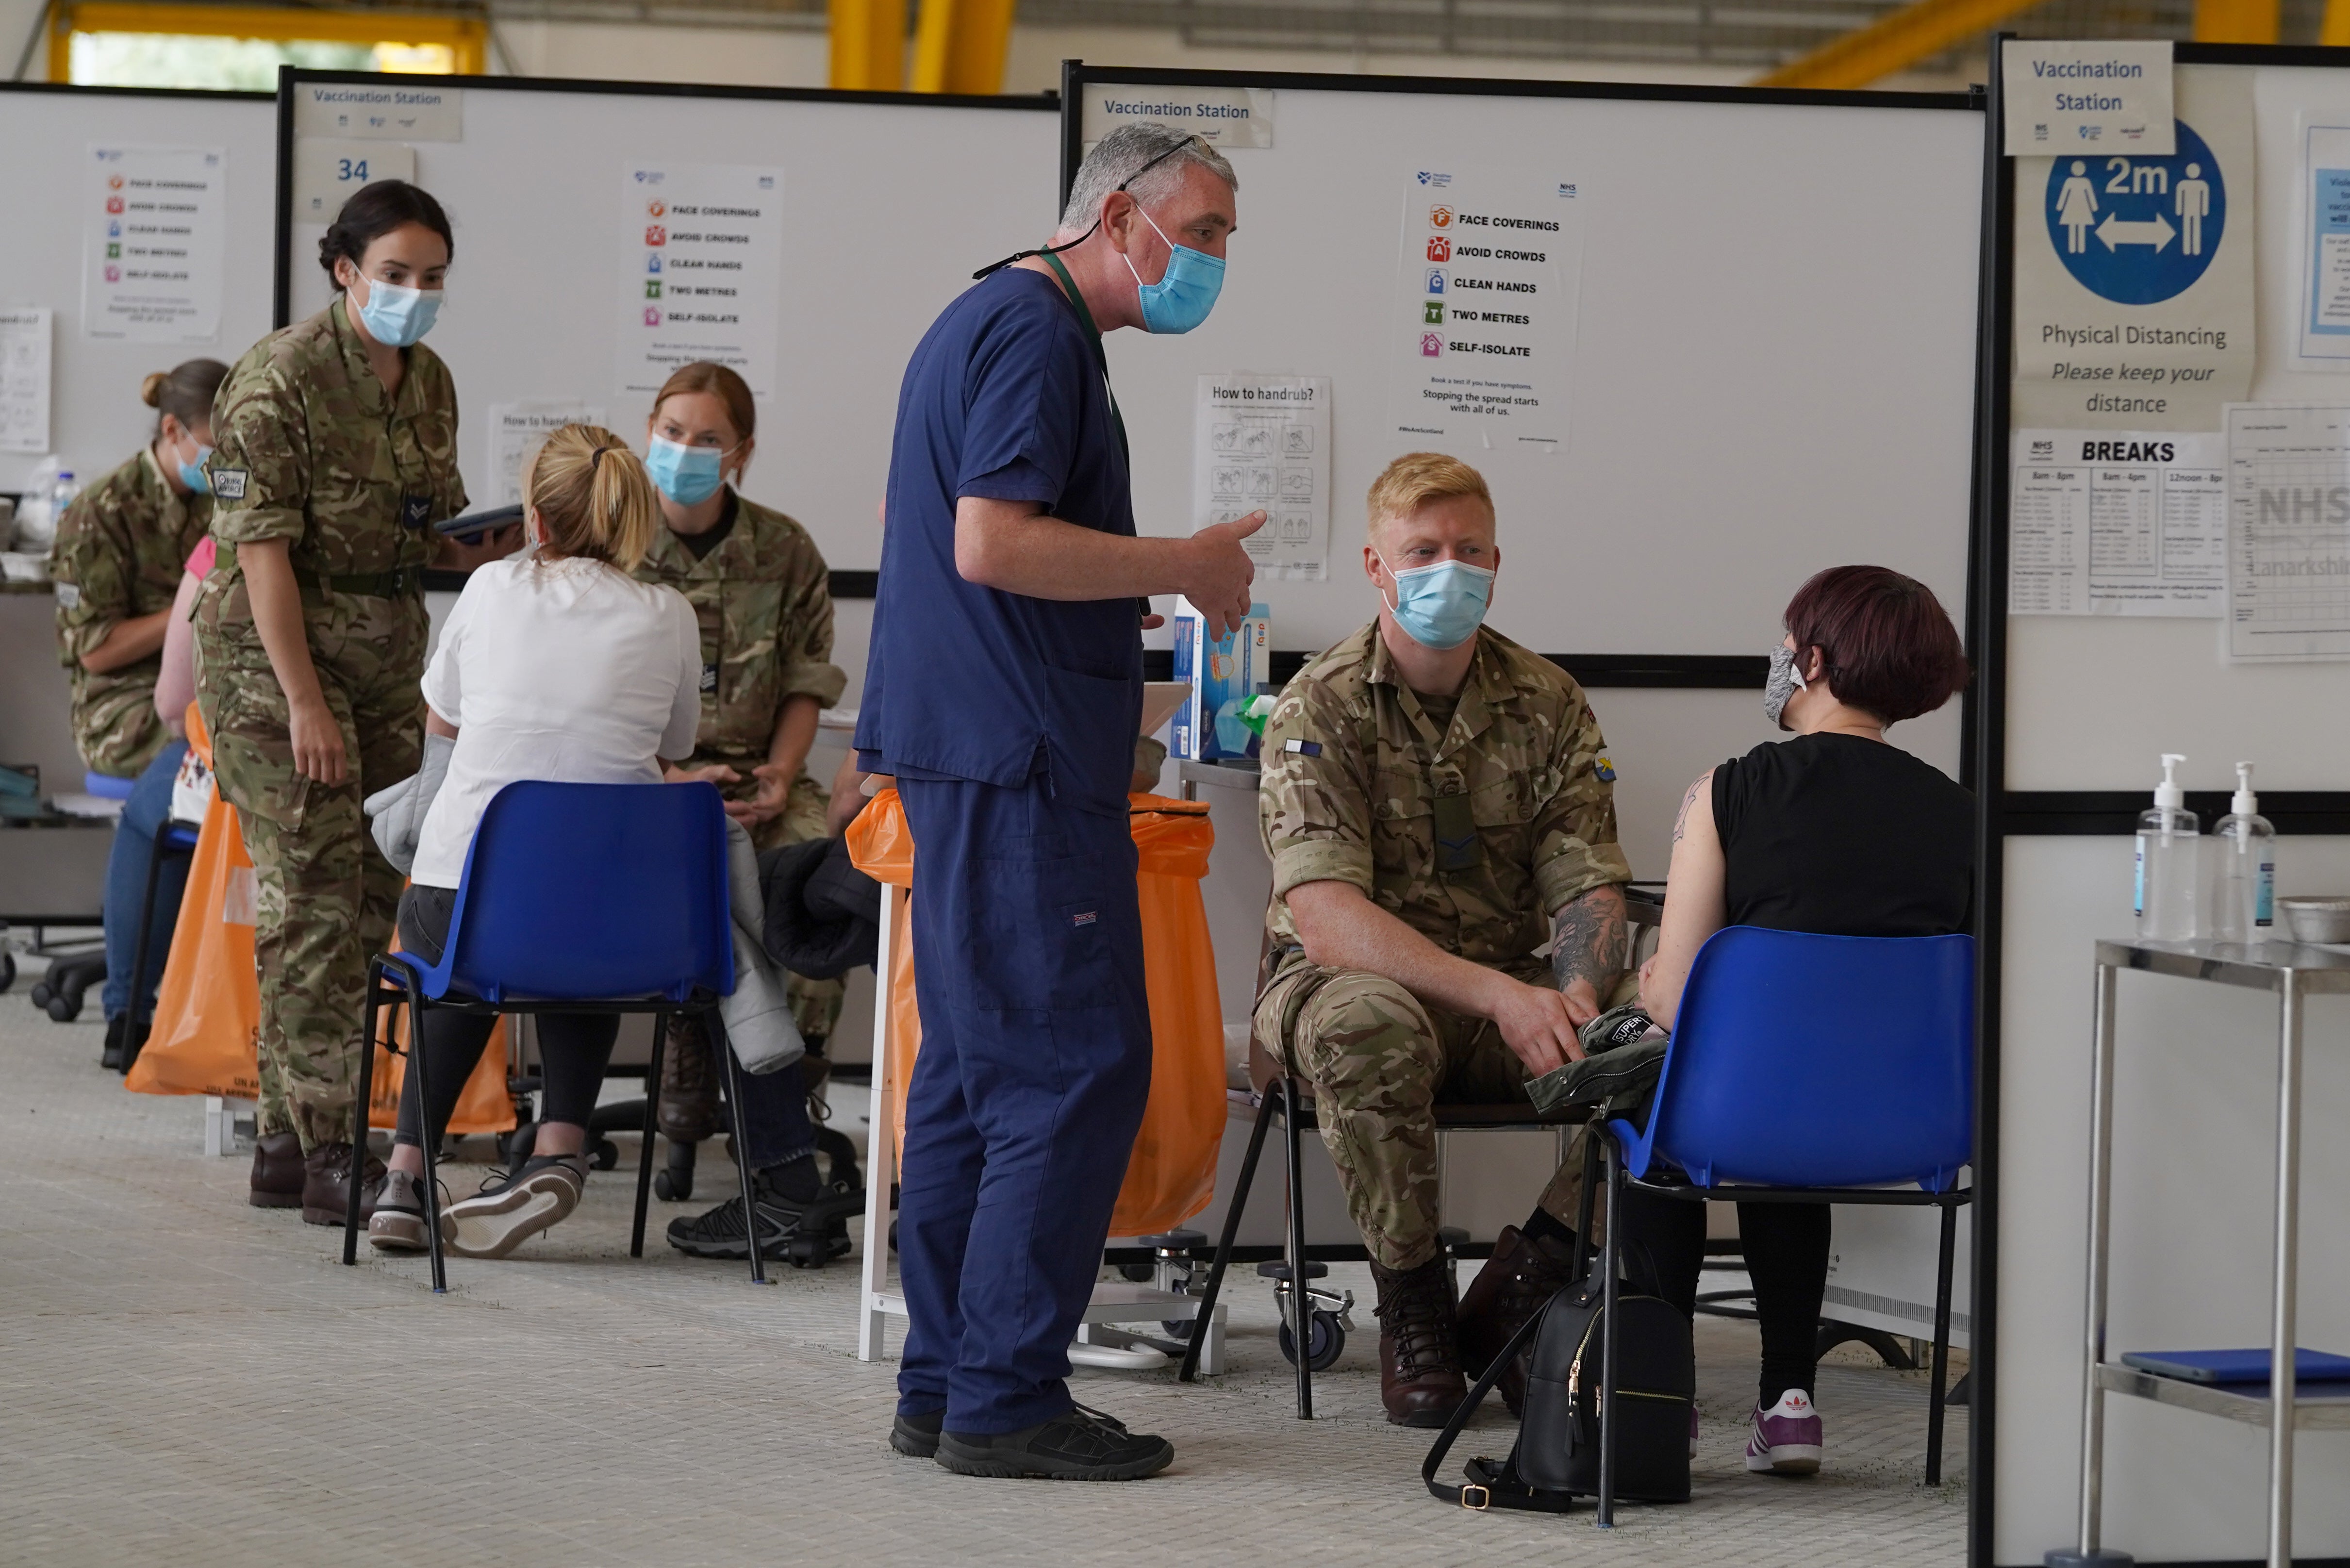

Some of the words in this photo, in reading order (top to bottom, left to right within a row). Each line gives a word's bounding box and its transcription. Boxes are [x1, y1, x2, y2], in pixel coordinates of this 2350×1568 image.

[2033, 60, 2142, 78] Vaccination
[314, 90, 391, 103] Vaccination
[395, 92, 441, 104] Station
[2055, 93, 2122, 110] Station
[1105, 100, 1191, 116] Vaccination
[1196, 103, 1249, 118] Station
[338, 158, 368, 182] 34
[2105, 157, 2168, 194] 2m
[672, 205, 698, 215] FACE
[702, 207, 761, 217] COVERINGS
[1459, 215, 1489, 225] FACE
[1493, 217, 1559, 231] COVERINGS
[671, 232, 702, 241] AVOID
[705, 234, 749, 244] CROWDS
[1456, 247, 1491, 257] AVOID
[1495, 250, 1545, 262] CROWDS
[670, 259, 704, 268] CLEAN
[707, 261, 743, 270] HANDS
[670, 285, 692, 295] TWO
[695, 286, 738, 297] METRES
[1455, 279, 1492, 290] CLEAN
[1497, 281, 1536, 293] HANDS
[668, 313, 739, 323] SELF-ISOLATE
[1452, 310, 1477, 320] TWO
[1482, 313, 1529, 324] METRES
[2042, 324, 2119, 347] Physical
[2126, 326, 2227, 349] Distancing
[1450, 342, 1530, 356] SELF-ISOLATE
[2052, 363, 2113, 380] Please
[2118, 363, 2166, 383] keep
[2170, 367, 2215, 384] your
[1213, 386, 1239, 399] How
[1242, 388, 1254, 399] to
[1258, 387, 1313, 400] handrub?
[1423, 390, 1462, 402] Stopping
[1466, 392, 1479, 401] the
[1482, 393, 1511, 404] spread
[1514, 396, 1539, 406] starts
[1450, 404, 1470, 413] with
[1473, 405, 1483, 413] all
[1486, 405, 1495, 413] of
[2086, 393, 2167, 413] distance
[503, 414, 527, 425] How
[529, 415, 540, 426] to
[2032, 441, 2053, 450] NHS
[2082, 442, 2174, 462] BREAKS
[2057, 472, 2075, 481] 8pm
[2128, 473, 2147, 481] 4pm
[2259, 487, 2350, 525] NHS
[1616, 1017, 1642, 1041] SUPER
